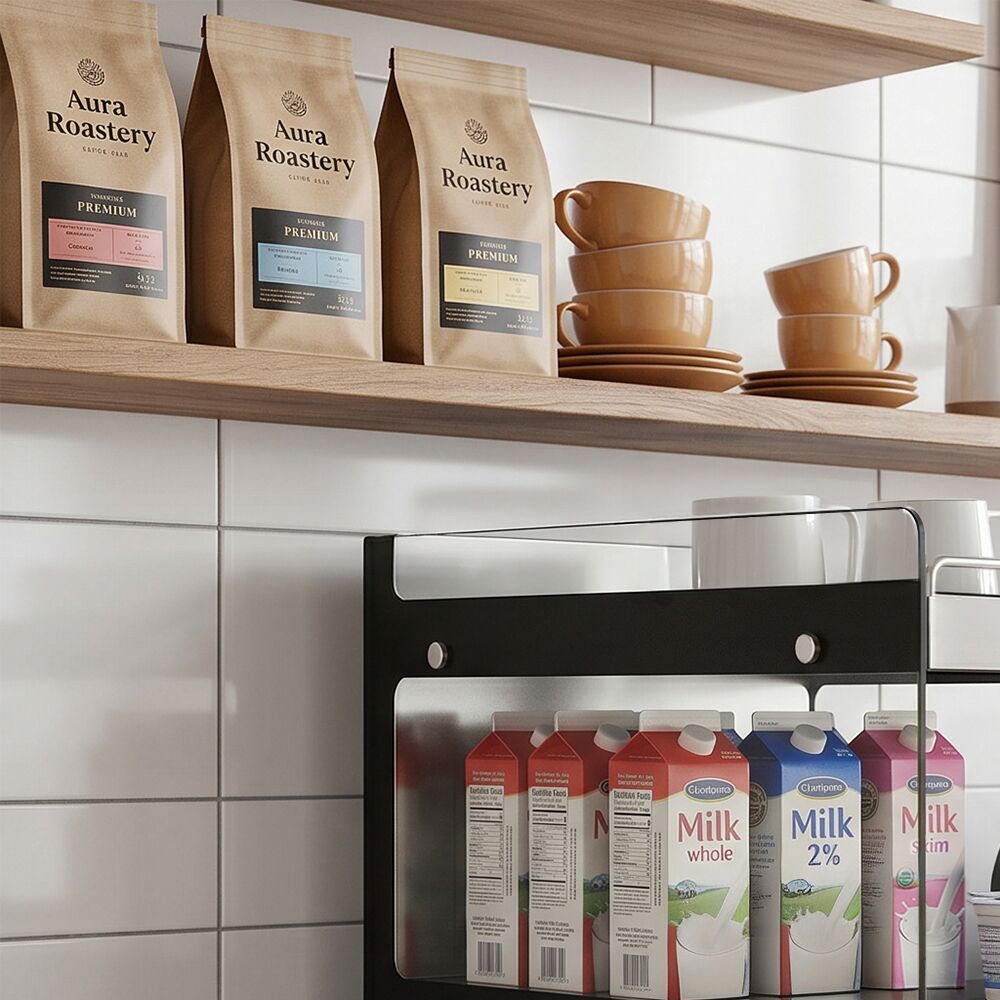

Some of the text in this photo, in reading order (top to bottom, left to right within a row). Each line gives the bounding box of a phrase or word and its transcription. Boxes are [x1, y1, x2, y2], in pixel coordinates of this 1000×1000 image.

[67, 89, 128, 117] Aura
[46, 111, 157, 152] Roastery
[274, 119, 329, 146] Aura
[255, 140, 356, 180] Roastery
[458, 147, 508, 172] Aura
[440, 167, 533, 205] Roastery
[76, 200, 138, 219] PREMIUM
[284, 226, 340, 242] PREMIUM
[467, 249, 519, 264] PREMIUM
[678, 809, 742, 843] Milk
[791, 807, 854, 840] Milk
[901, 804, 959, 834] Milk
[687, 845, 733, 862] whole
[807, 844, 841, 866] 2%
